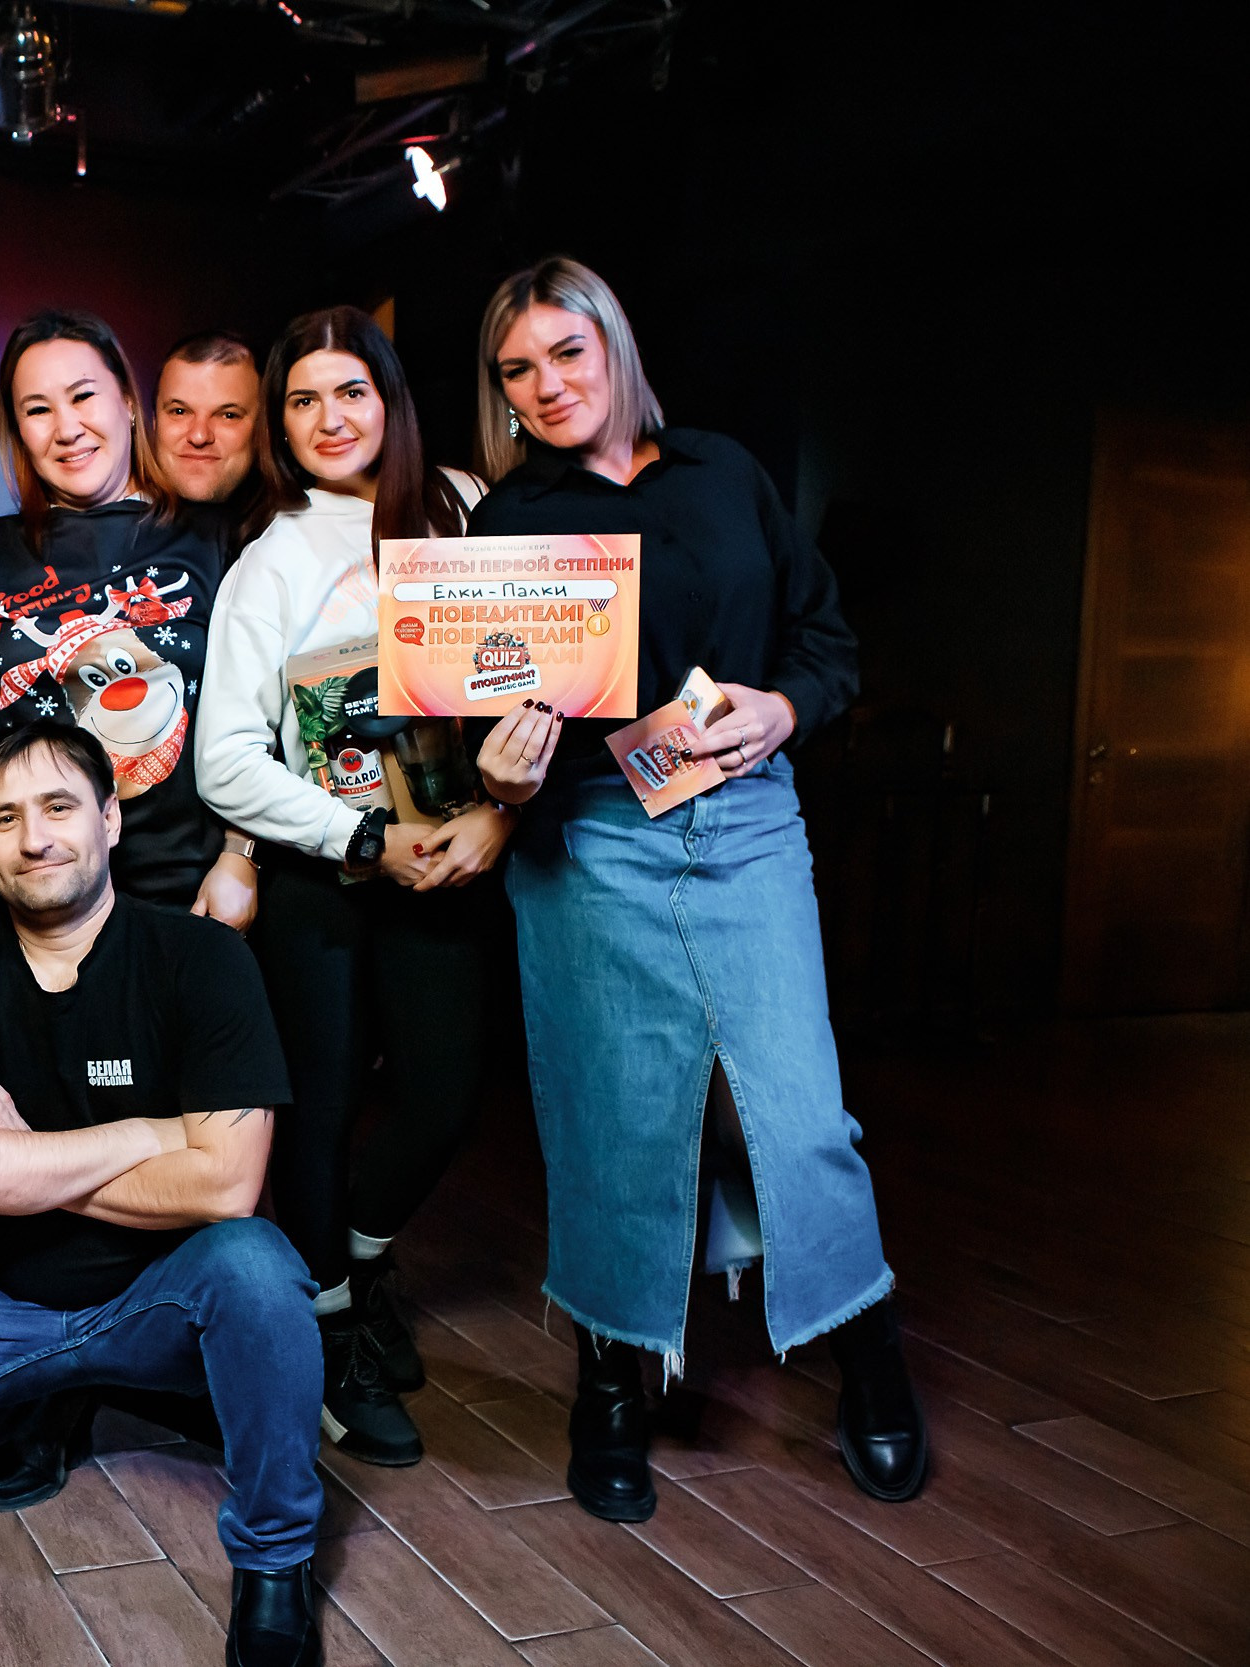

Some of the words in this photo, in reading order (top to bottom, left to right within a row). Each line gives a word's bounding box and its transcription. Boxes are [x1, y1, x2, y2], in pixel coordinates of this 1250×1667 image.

[386, 560, 475, 575] ЛАУРЕАТЫ
[480, 555, 550, 573] ПЕРВОЙ
[553, 557, 634, 571] СТЕПЕНИ
[429, 604, 584, 623] ПОБЕДИТЕЛИ!
[481, 651, 521, 667] QUIZ
[493, 683, 517, 692] #MUSIC
[517, 679, 536, 688] GAME
[653, 749, 673, 773] QUIZ
[334, 763, 380, 786] BACARDÍ
[87, 1059, 133, 1077] БЕЛАЯ
[88, 1075, 134, 1086] ФУТБОЛКА
